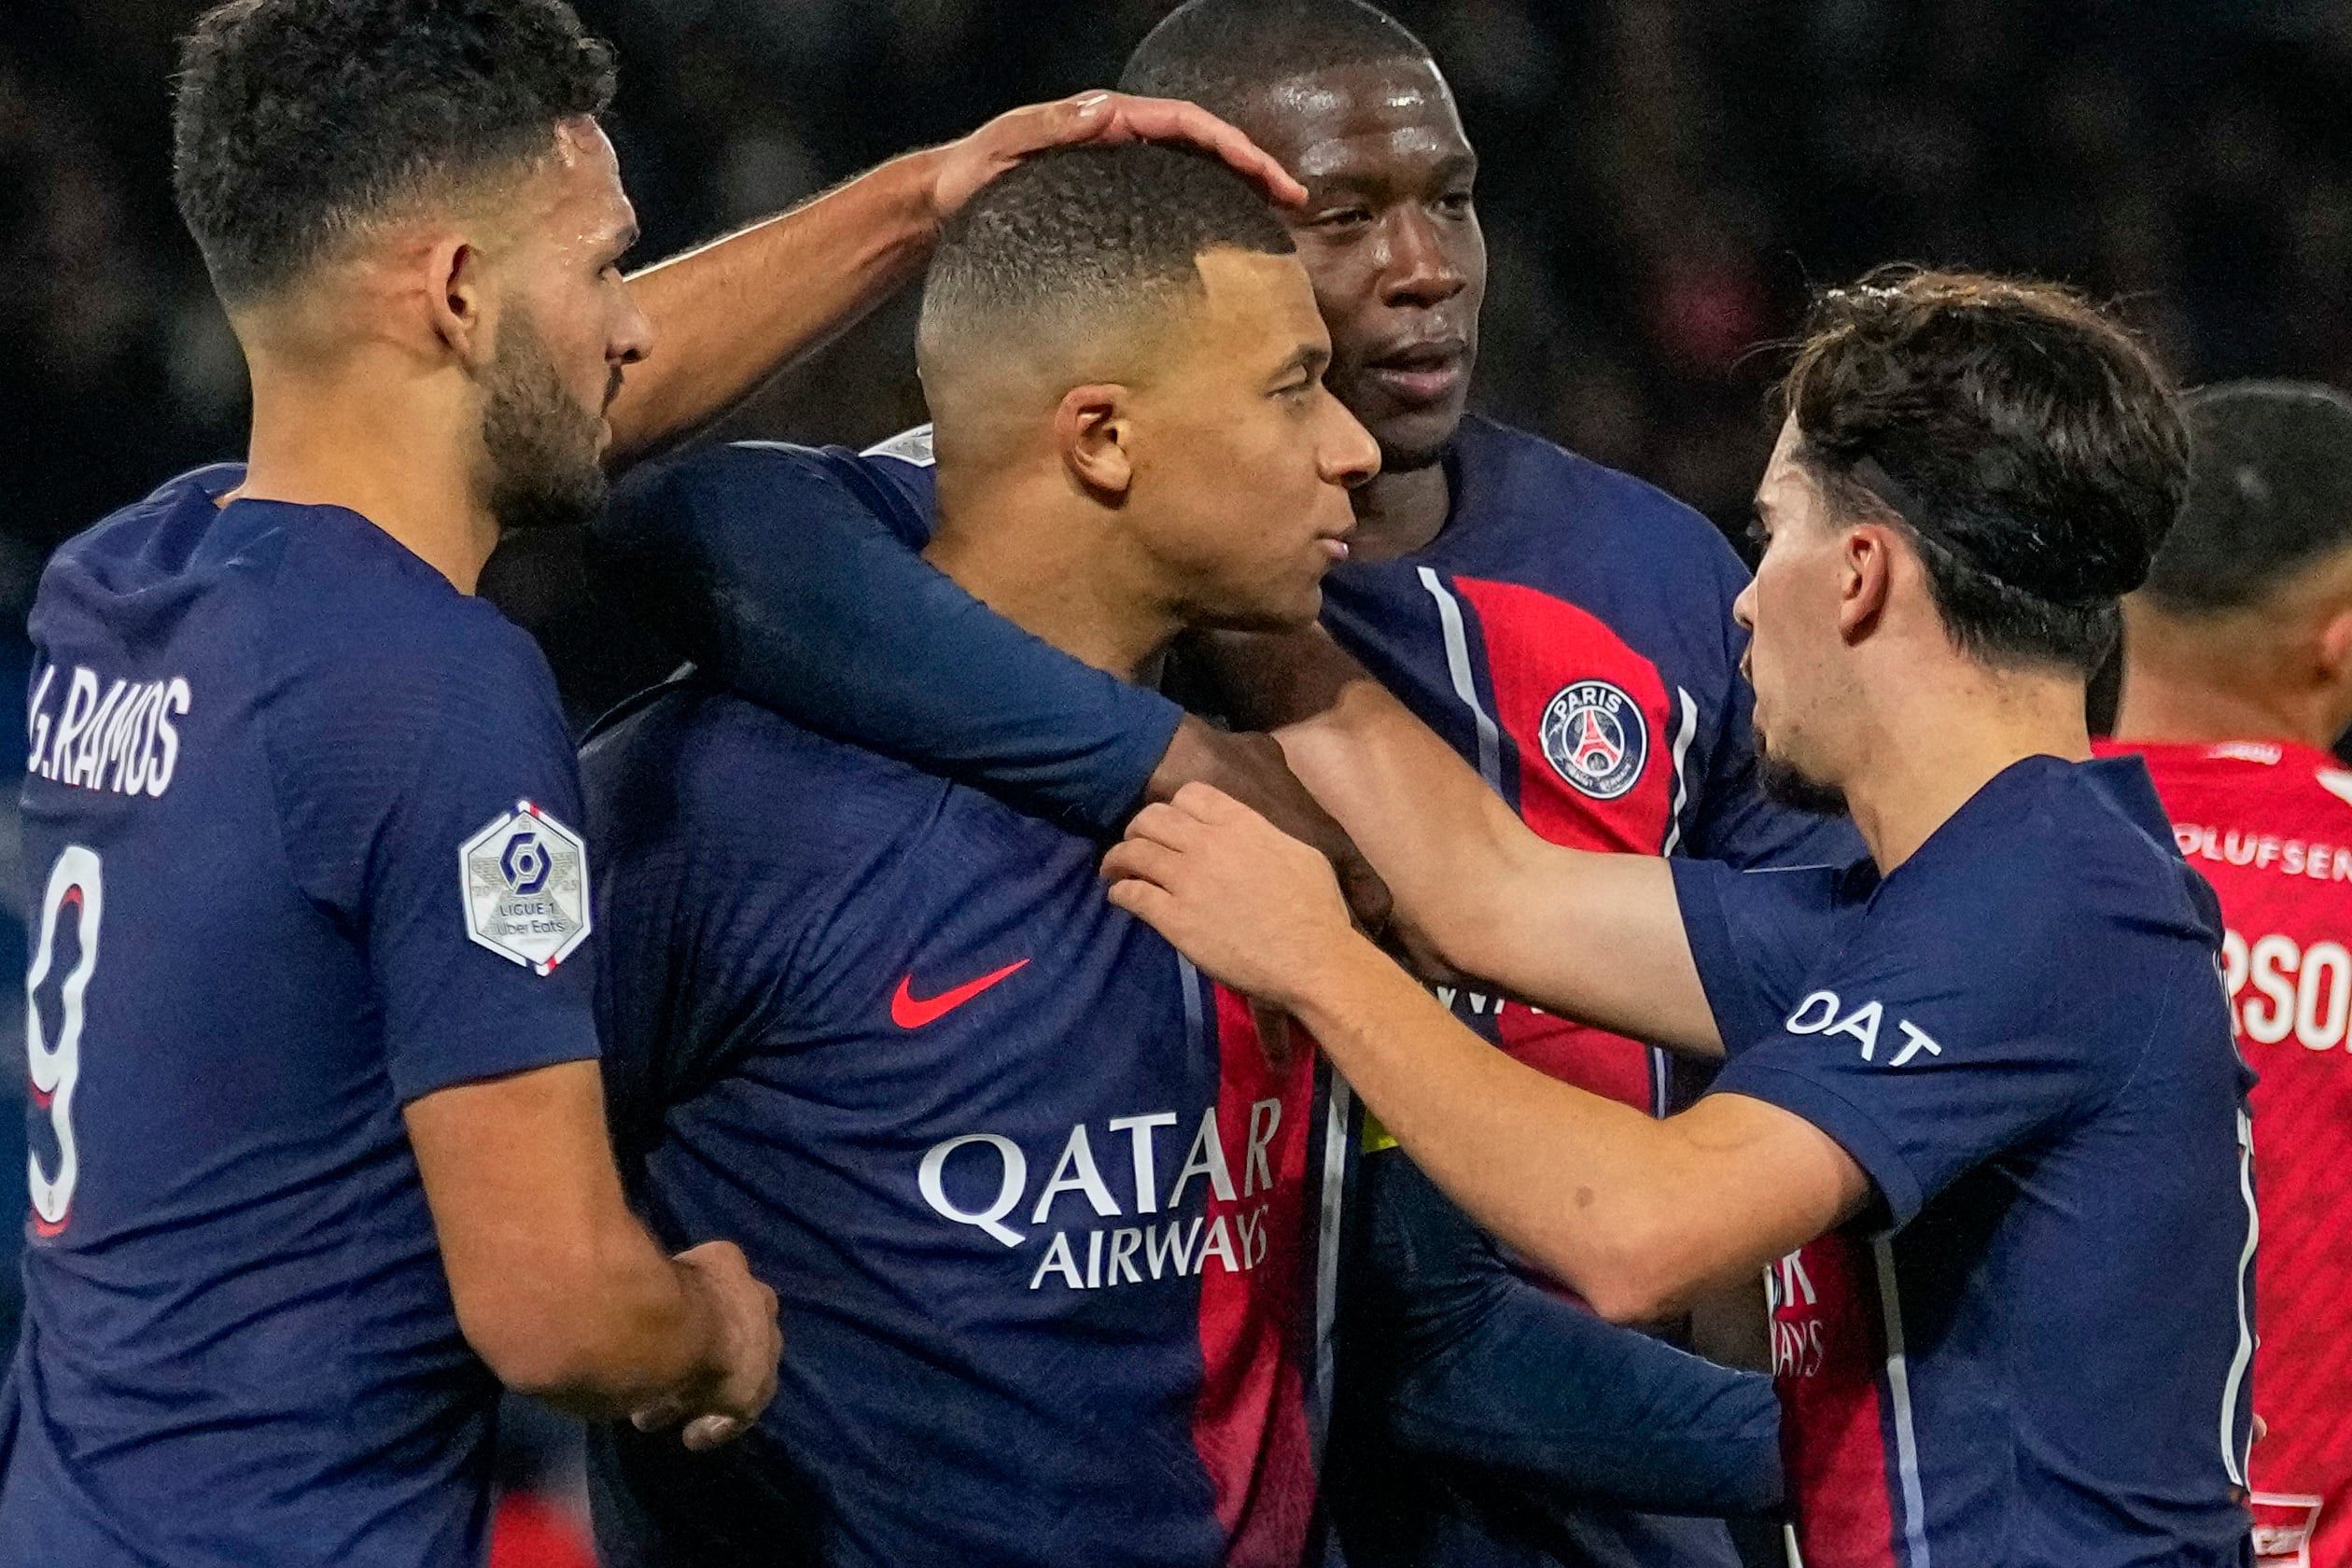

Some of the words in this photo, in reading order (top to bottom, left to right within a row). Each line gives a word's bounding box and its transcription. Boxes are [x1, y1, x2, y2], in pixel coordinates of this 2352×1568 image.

[29, 665, 192, 797] G.RAMOS
[1553, 687, 1623, 721] PARIS
[499, 902, 544, 917] LIGUE
[530, 919, 566, 933] Eats
[27, 846, 102, 1226] 9
[918, 1098, 1282, 1248] QATAR
[1029, 1204, 1270, 1291] AIRWAYS
[1771, 1319, 1823, 1378] AYS
